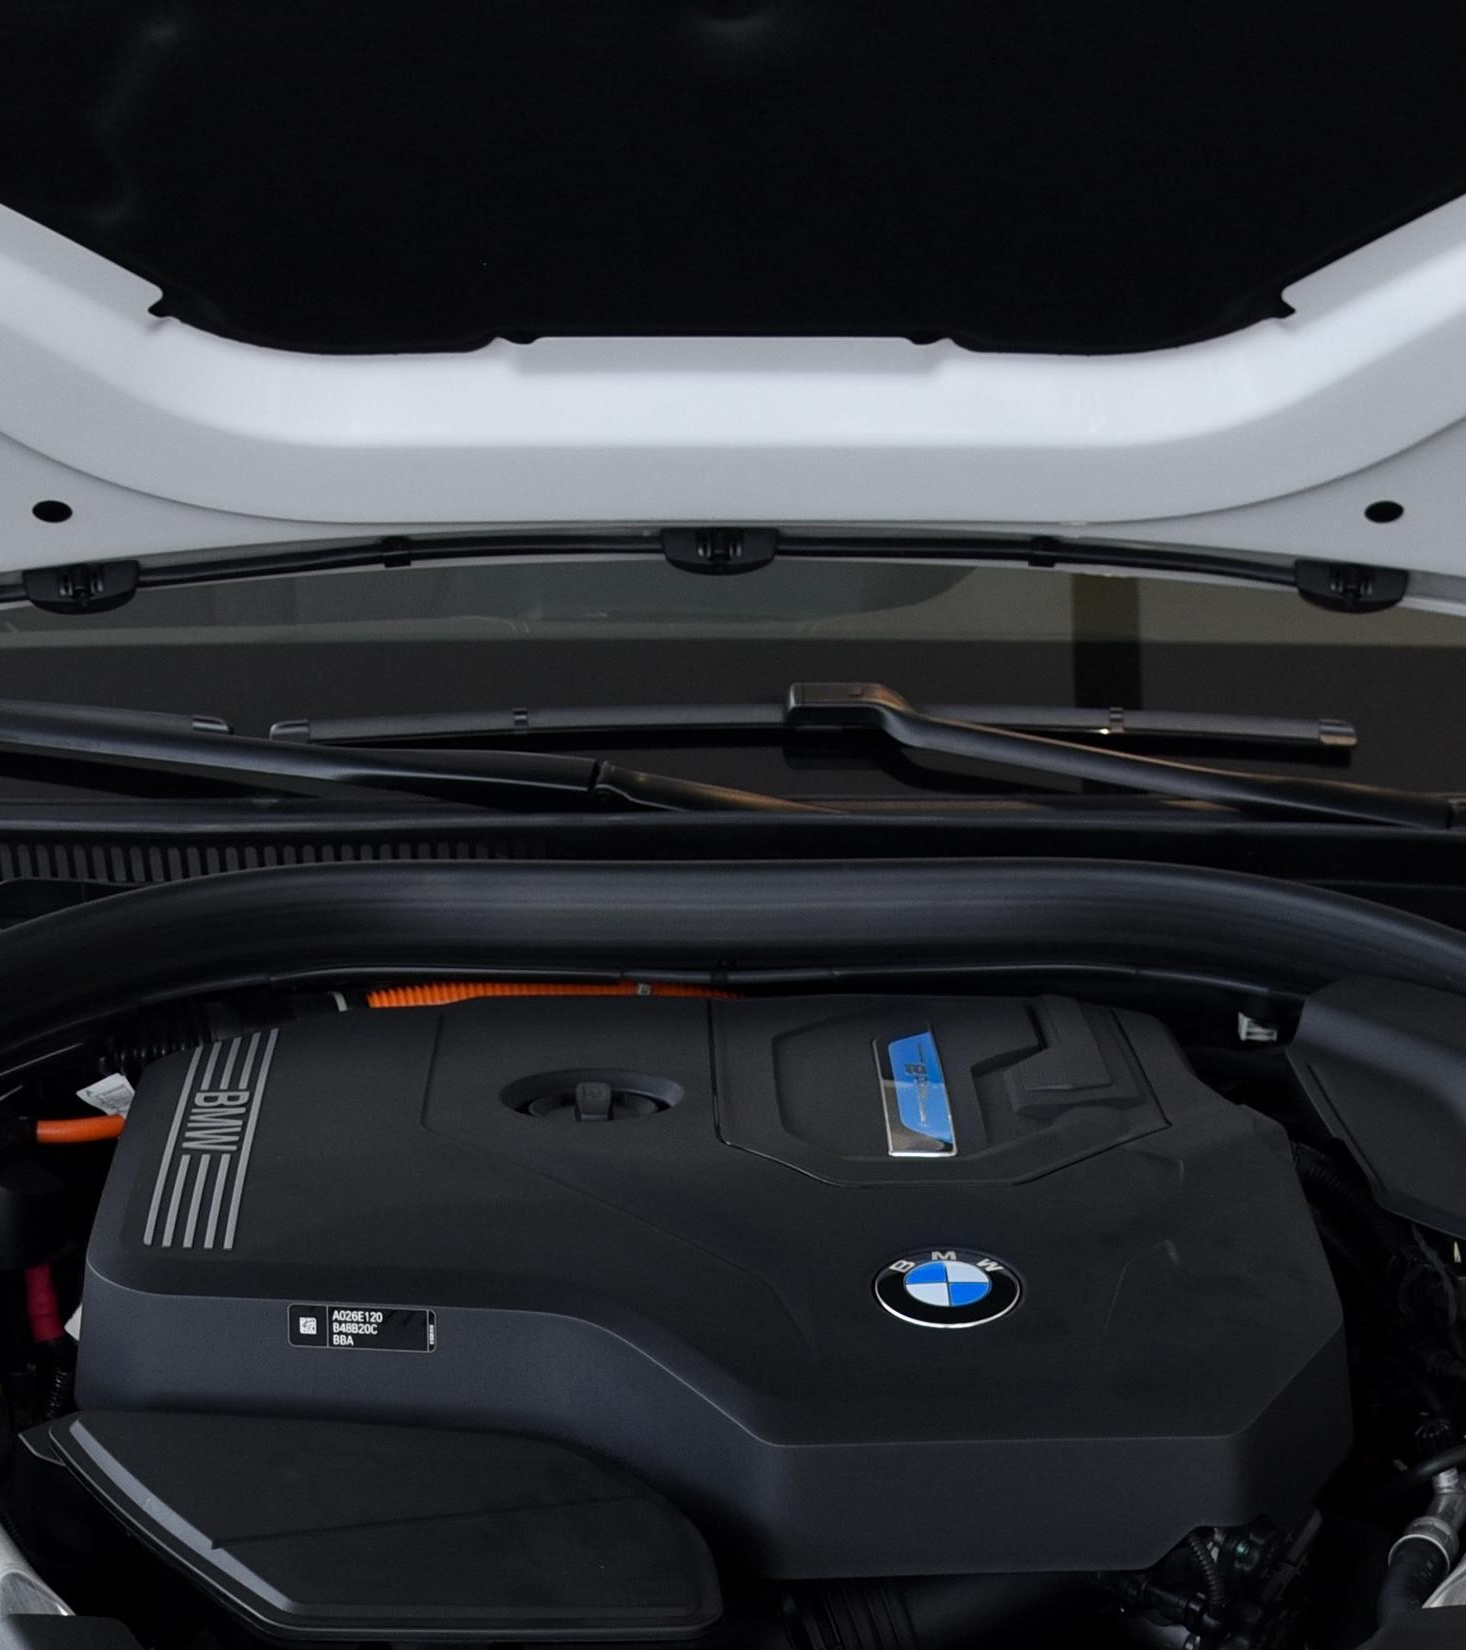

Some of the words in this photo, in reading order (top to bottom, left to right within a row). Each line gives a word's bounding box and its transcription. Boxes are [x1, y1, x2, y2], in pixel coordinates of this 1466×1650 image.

[182, 1091, 250, 1151] BMW
[889, 1251, 1003, 1272] BMW
[332, 1310, 383, 1323] A026E120
[333, 1322, 378, 1335] B48B20C
[333, 1335, 354, 1346] BBA
